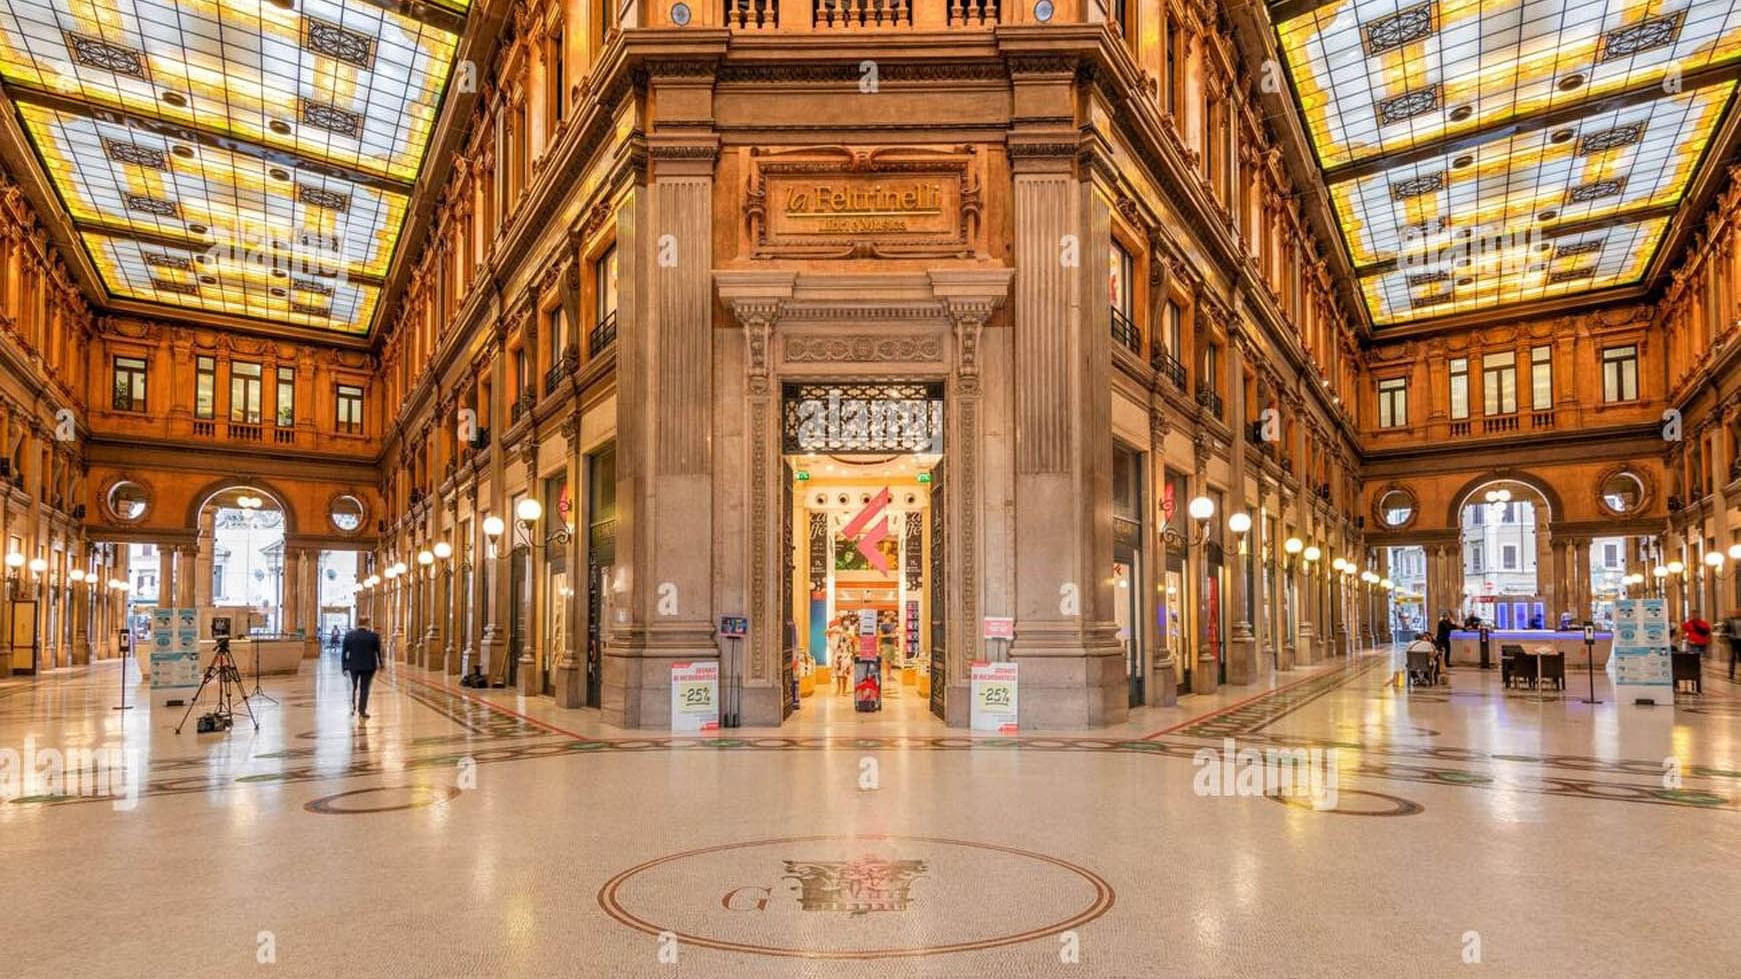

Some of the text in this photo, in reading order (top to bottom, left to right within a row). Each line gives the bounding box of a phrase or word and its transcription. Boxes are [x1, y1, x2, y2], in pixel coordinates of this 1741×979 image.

[786, 186, 808, 211] la
[680, 687, 711, 703] -25%
[979, 687, 1010, 703] -25%
[722, 886, 772, 911] G
